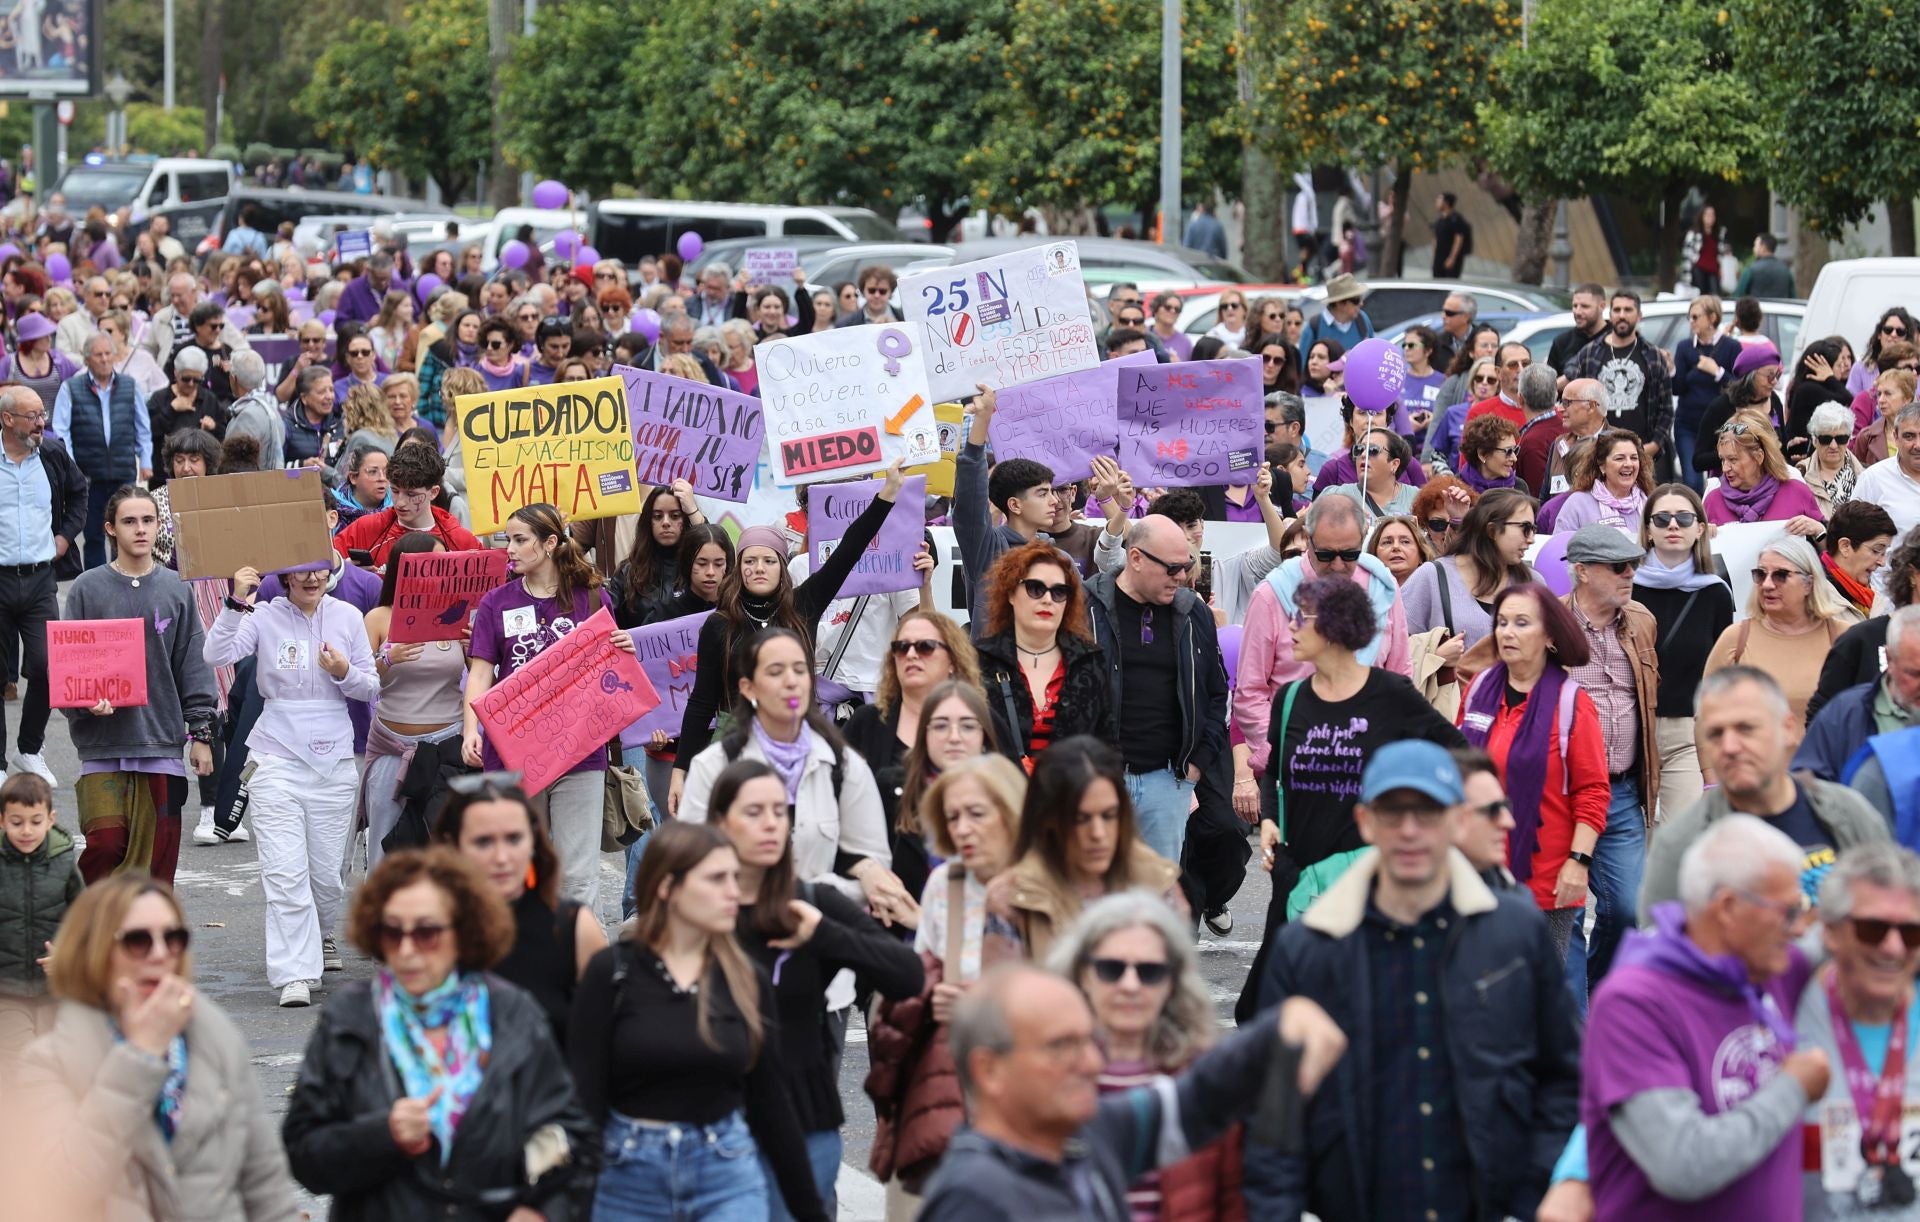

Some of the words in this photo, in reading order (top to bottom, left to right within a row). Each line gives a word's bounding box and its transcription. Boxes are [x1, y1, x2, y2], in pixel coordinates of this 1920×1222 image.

[922, 278, 970, 317] 25
[765, 343, 860, 381] Quiero
[935, 351, 957, 375] de
[1136, 372, 1158, 394] A
[772, 382, 865, 412] volver
[877, 382, 890, 395] a
[1134, 398, 1167, 417] ME
[463, 388, 628, 444] CUIDADO!
[731, 404, 761, 440] NO
[777, 418, 825, 437] casa
[837, 408, 868, 425] sin
[996, 417, 1026, 441] DE
[1030, 398, 1116, 434] JUSTICIA
[1127, 420, 1160, 437] LAS
[1179, 418, 1258, 436] MUJERES
[475, 447, 510, 469] EL
[517, 438, 634, 463] MACHISMO
[637, 421, 681, 455] CORTA
[694, 433, 728, 465] TU
[783, 431, 876, 471] MIEDO
[1196, 439, 1229, 456] LAS
[1150, 461, 1220, 481] ACOSO
[491, 462, 598, 525] MATA
[464, 555, 490, 577] QUE
[53, 630, 96, 645] NUNCA
[676, 628, 694, 651] TE
[1305, 723, 1331, 745] girls
[1331, 725, 1355, 746] just
[1296, 744, 1331, 755] wanna
[1334, 740, 1363, 757] have
[228, 799, 244, 823] FIND
